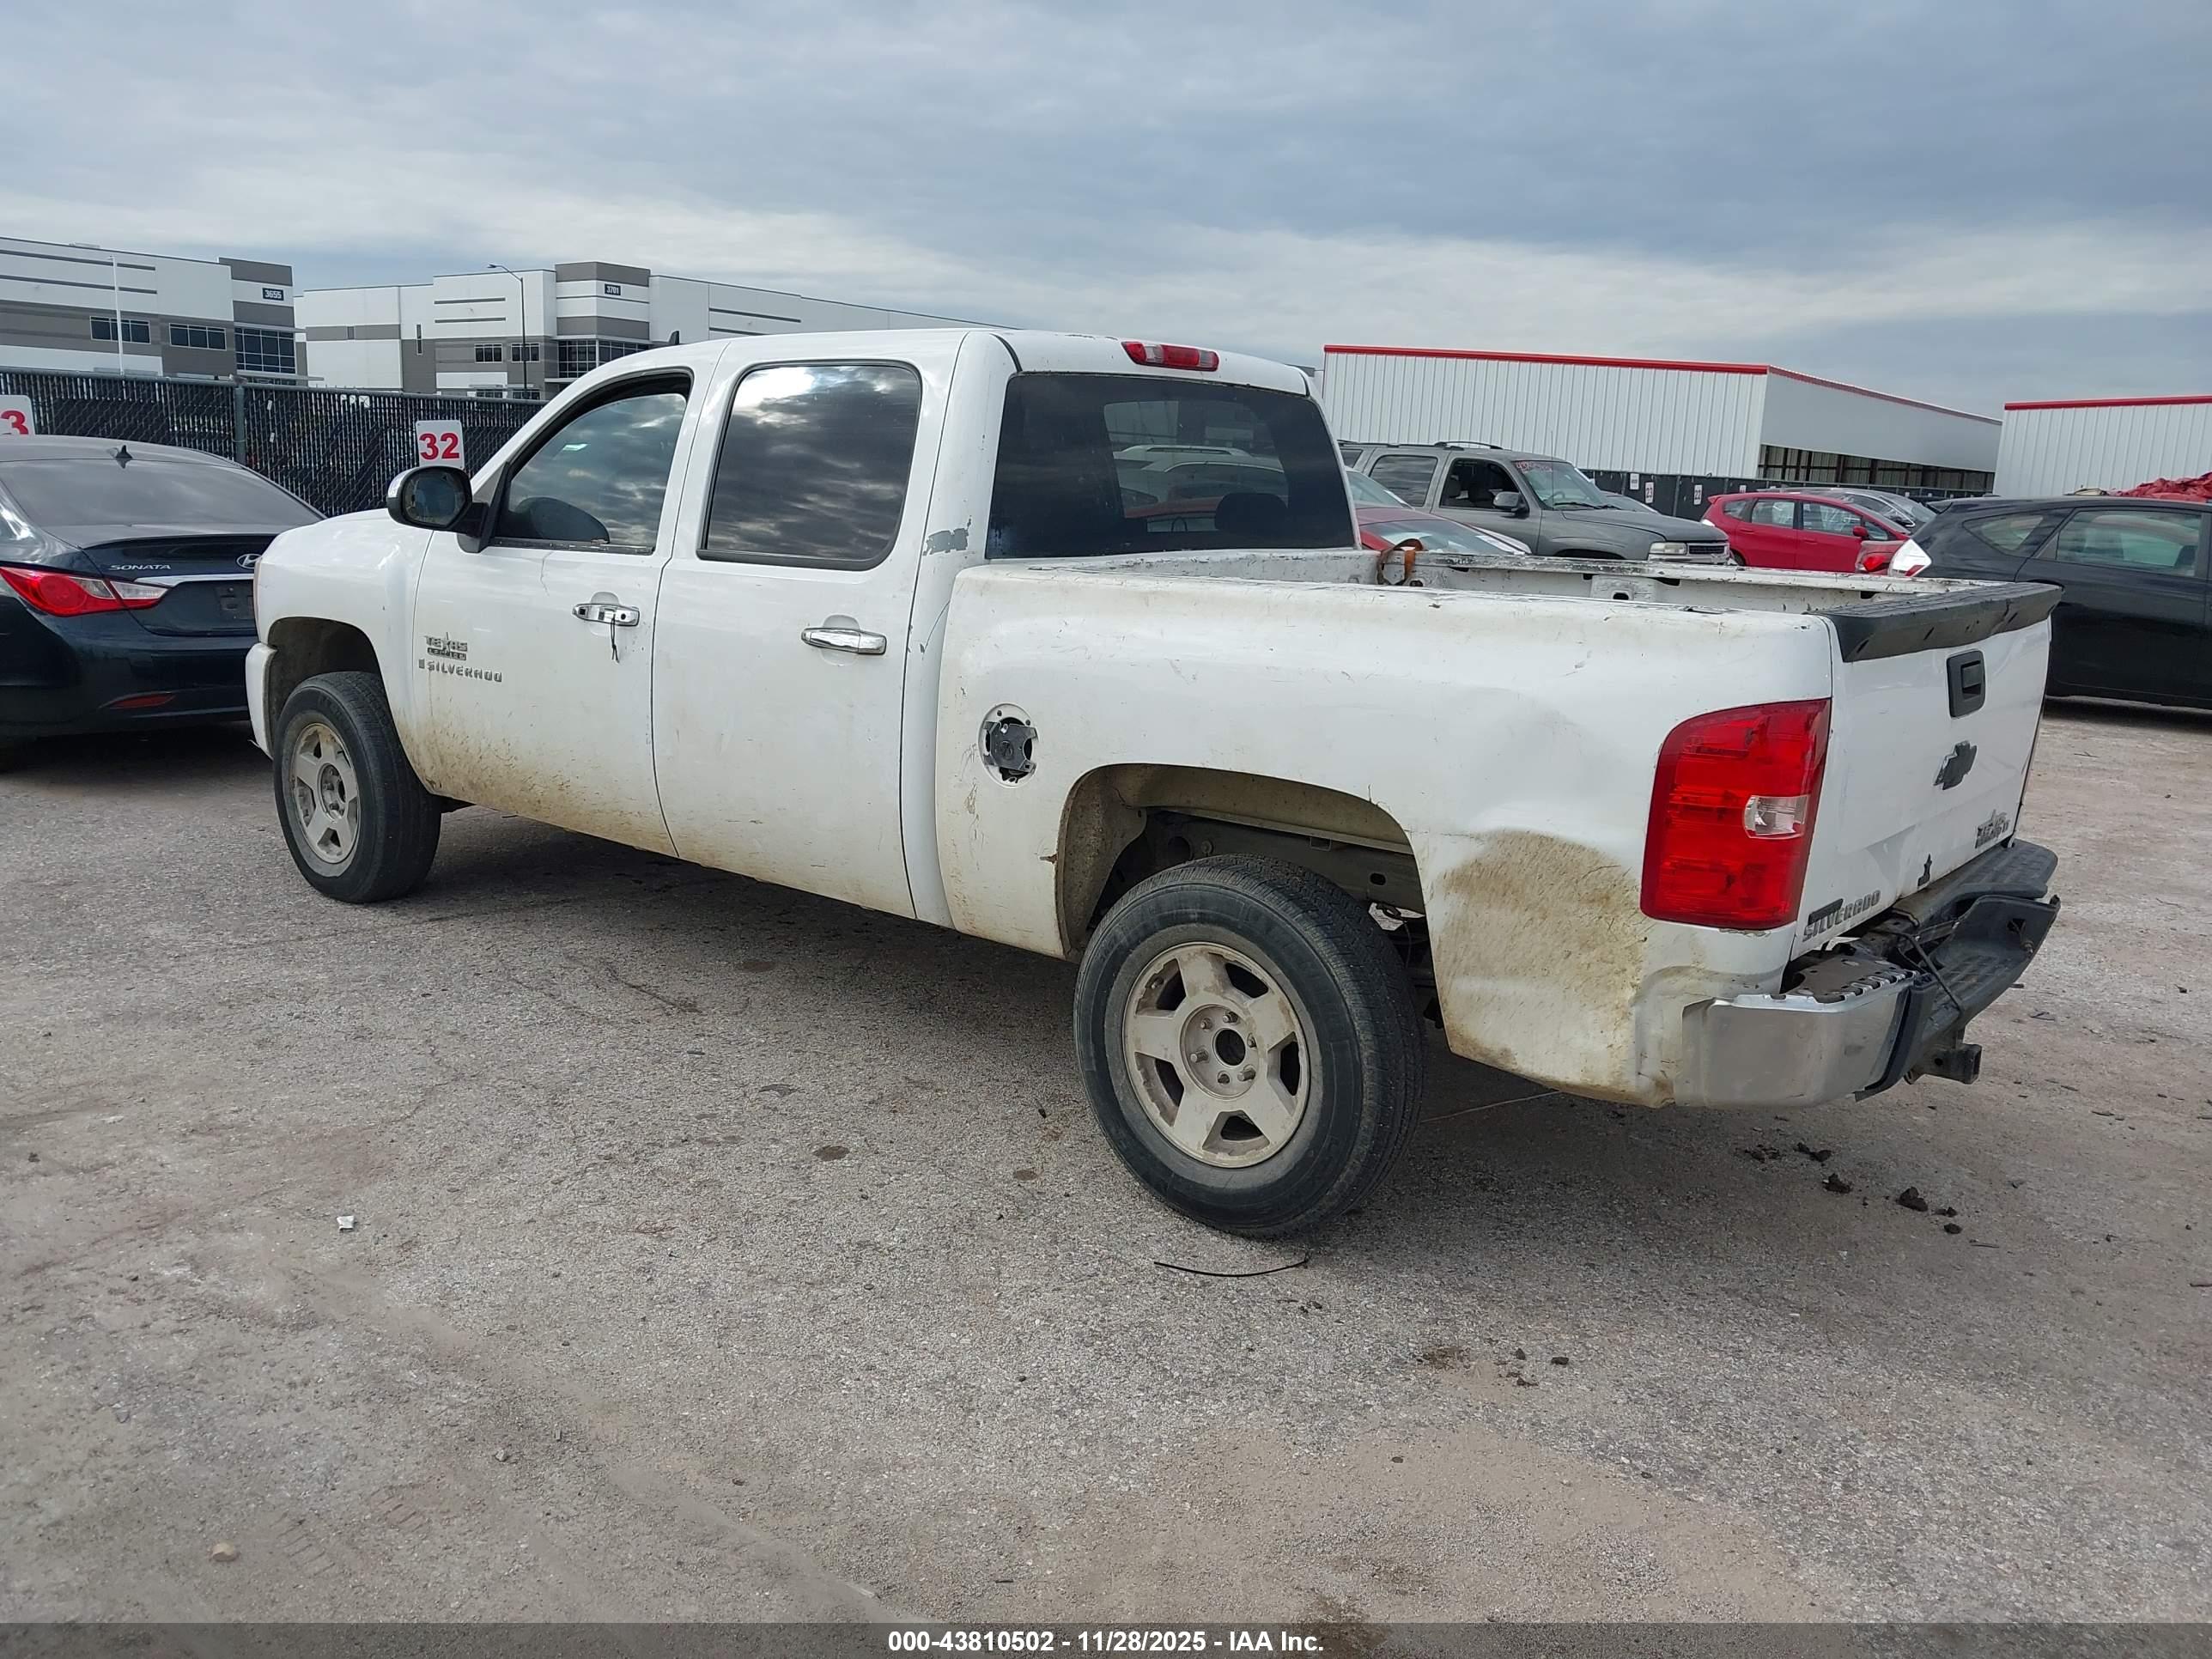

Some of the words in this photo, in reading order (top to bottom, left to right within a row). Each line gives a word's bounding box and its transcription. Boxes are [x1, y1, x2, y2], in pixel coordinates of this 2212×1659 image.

[264, 289, 282, 299] 3655
[419, 433, 459, 460] 32
[427, 660, 502, 683] SILVERADO
[1802, 890, 1881, 942] SILVERADO
